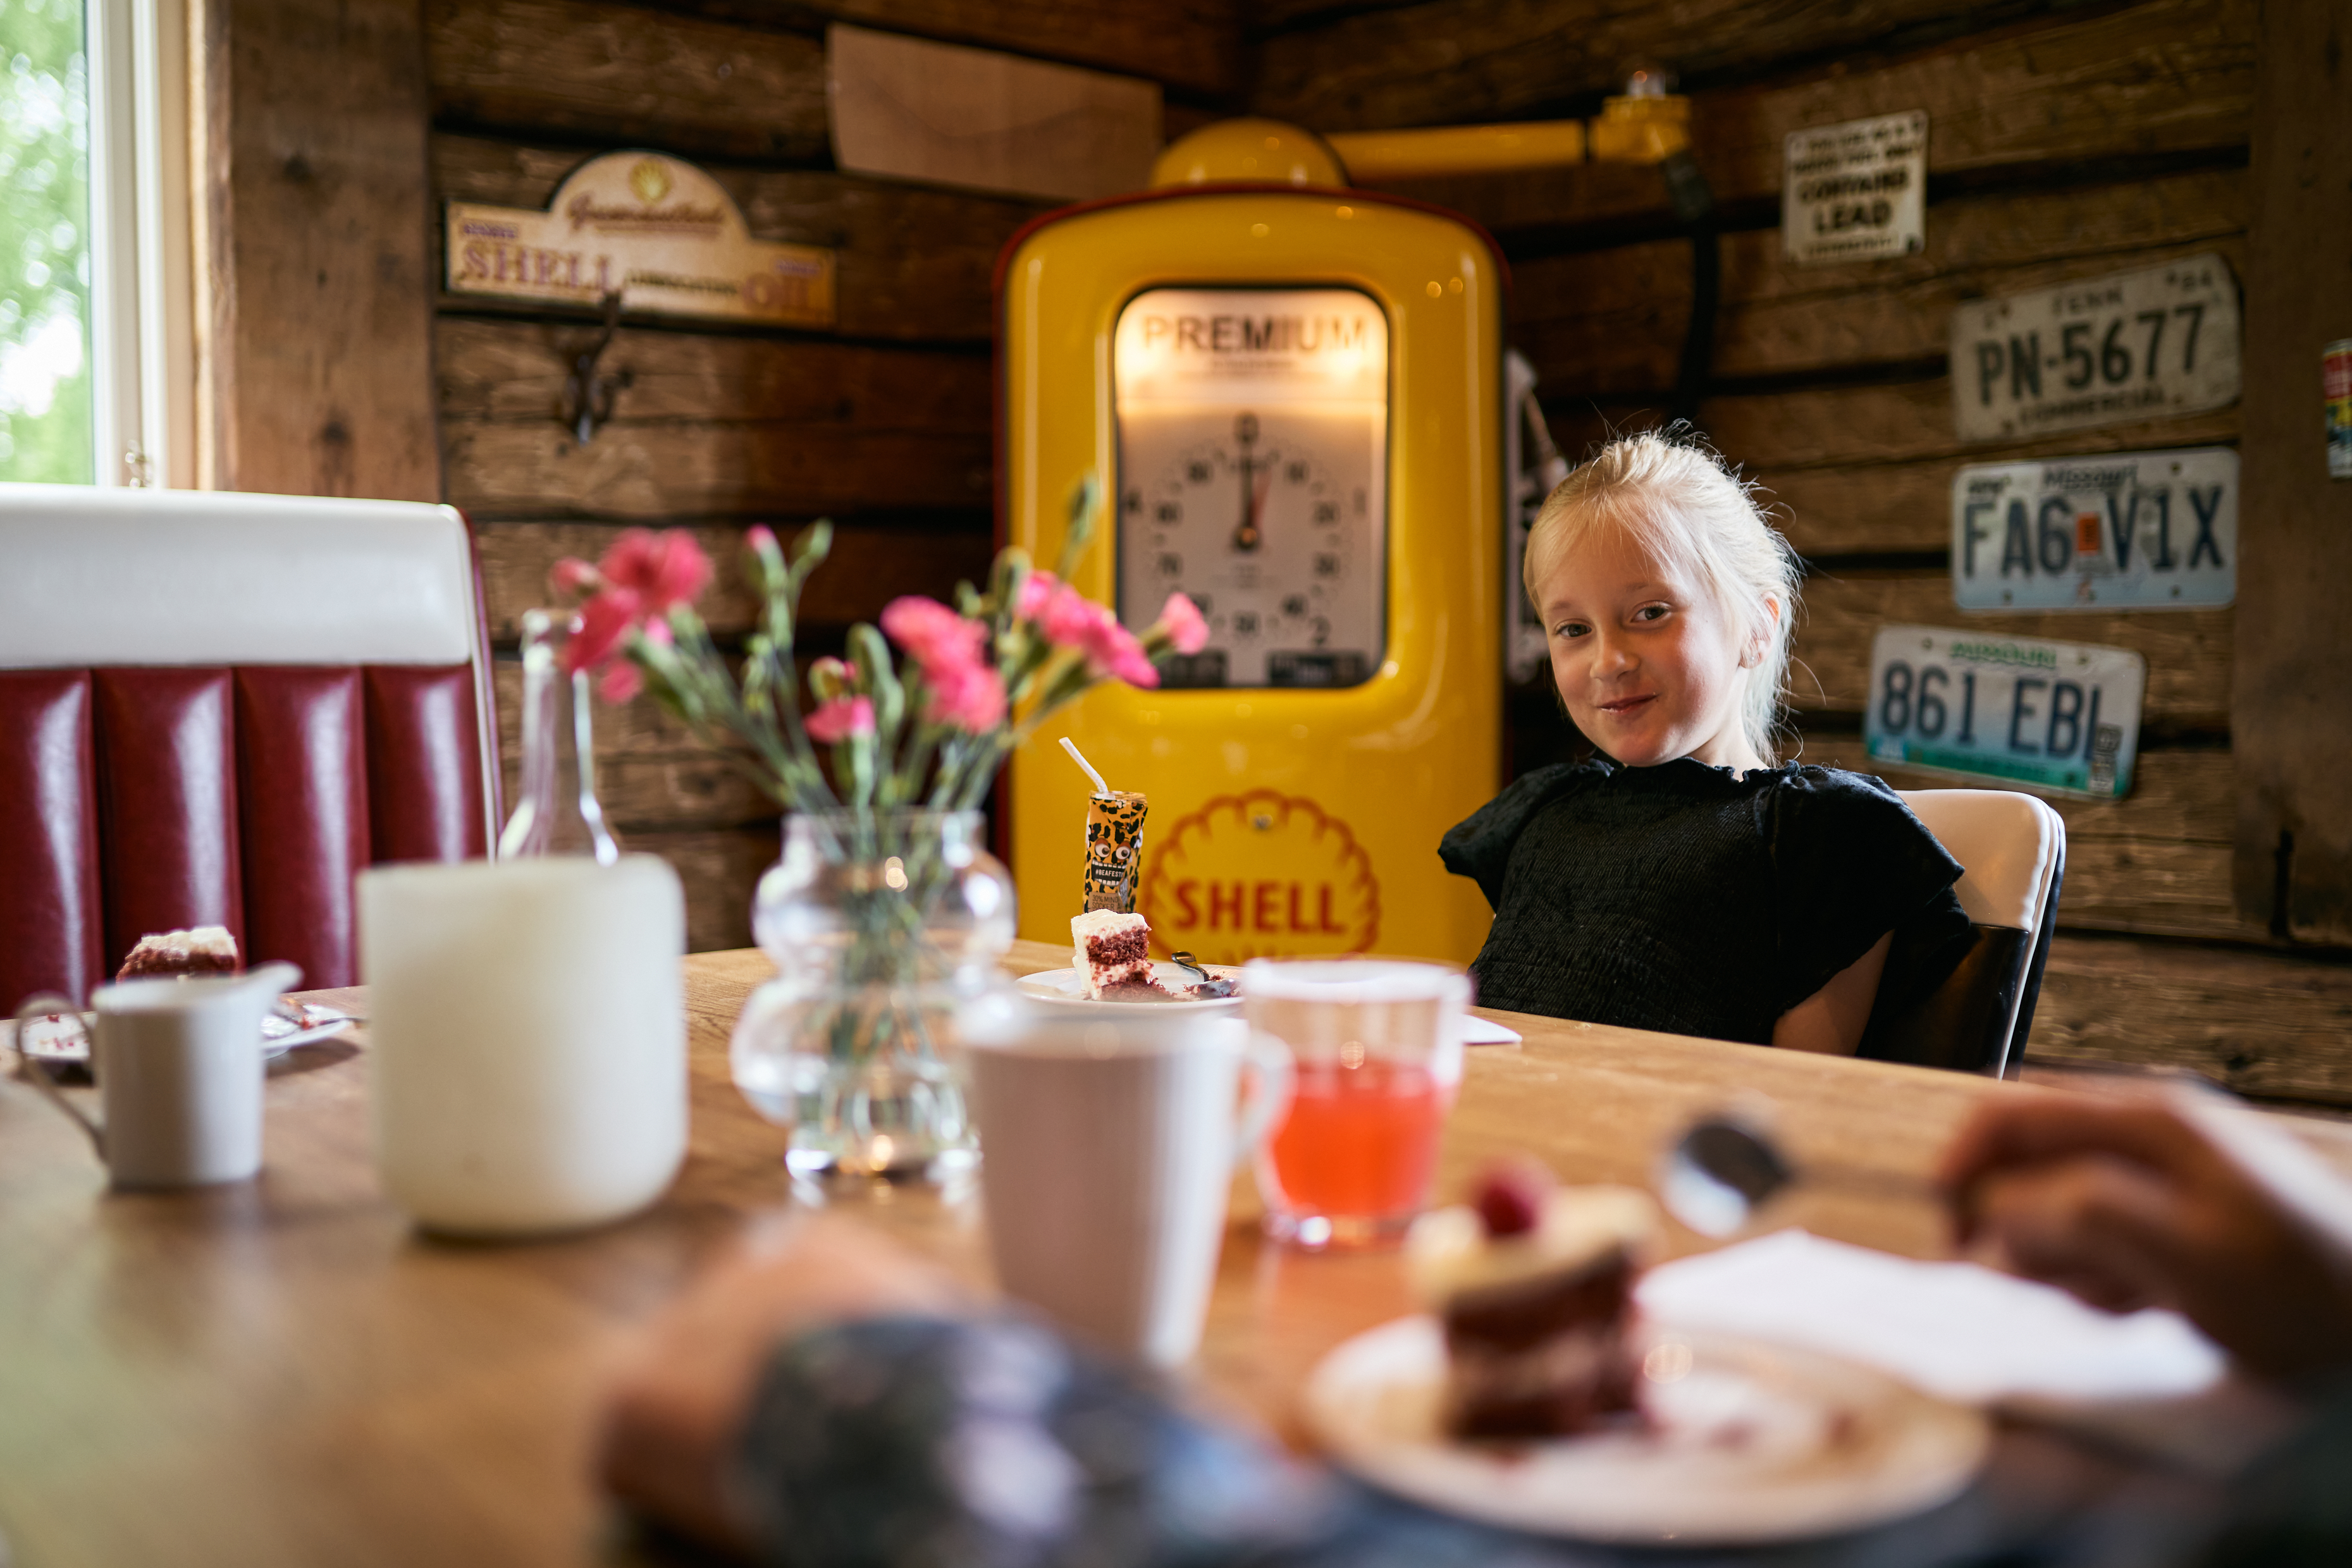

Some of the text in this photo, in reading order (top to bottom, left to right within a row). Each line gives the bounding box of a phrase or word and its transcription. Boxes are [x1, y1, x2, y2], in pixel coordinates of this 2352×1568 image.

[1814, 199, 1892, 233] LEAD
[462, 242, 620, 295] SHELL
[1143, 315, 1365, 353] PREMIUM
[1976, 303, 2205, 407] PN-5677
[1964, 485, 2224, 579] FA6 V1X
[1881, 658, 1976, 745] 861
[1173, 880, 1346, 933] SHELL
